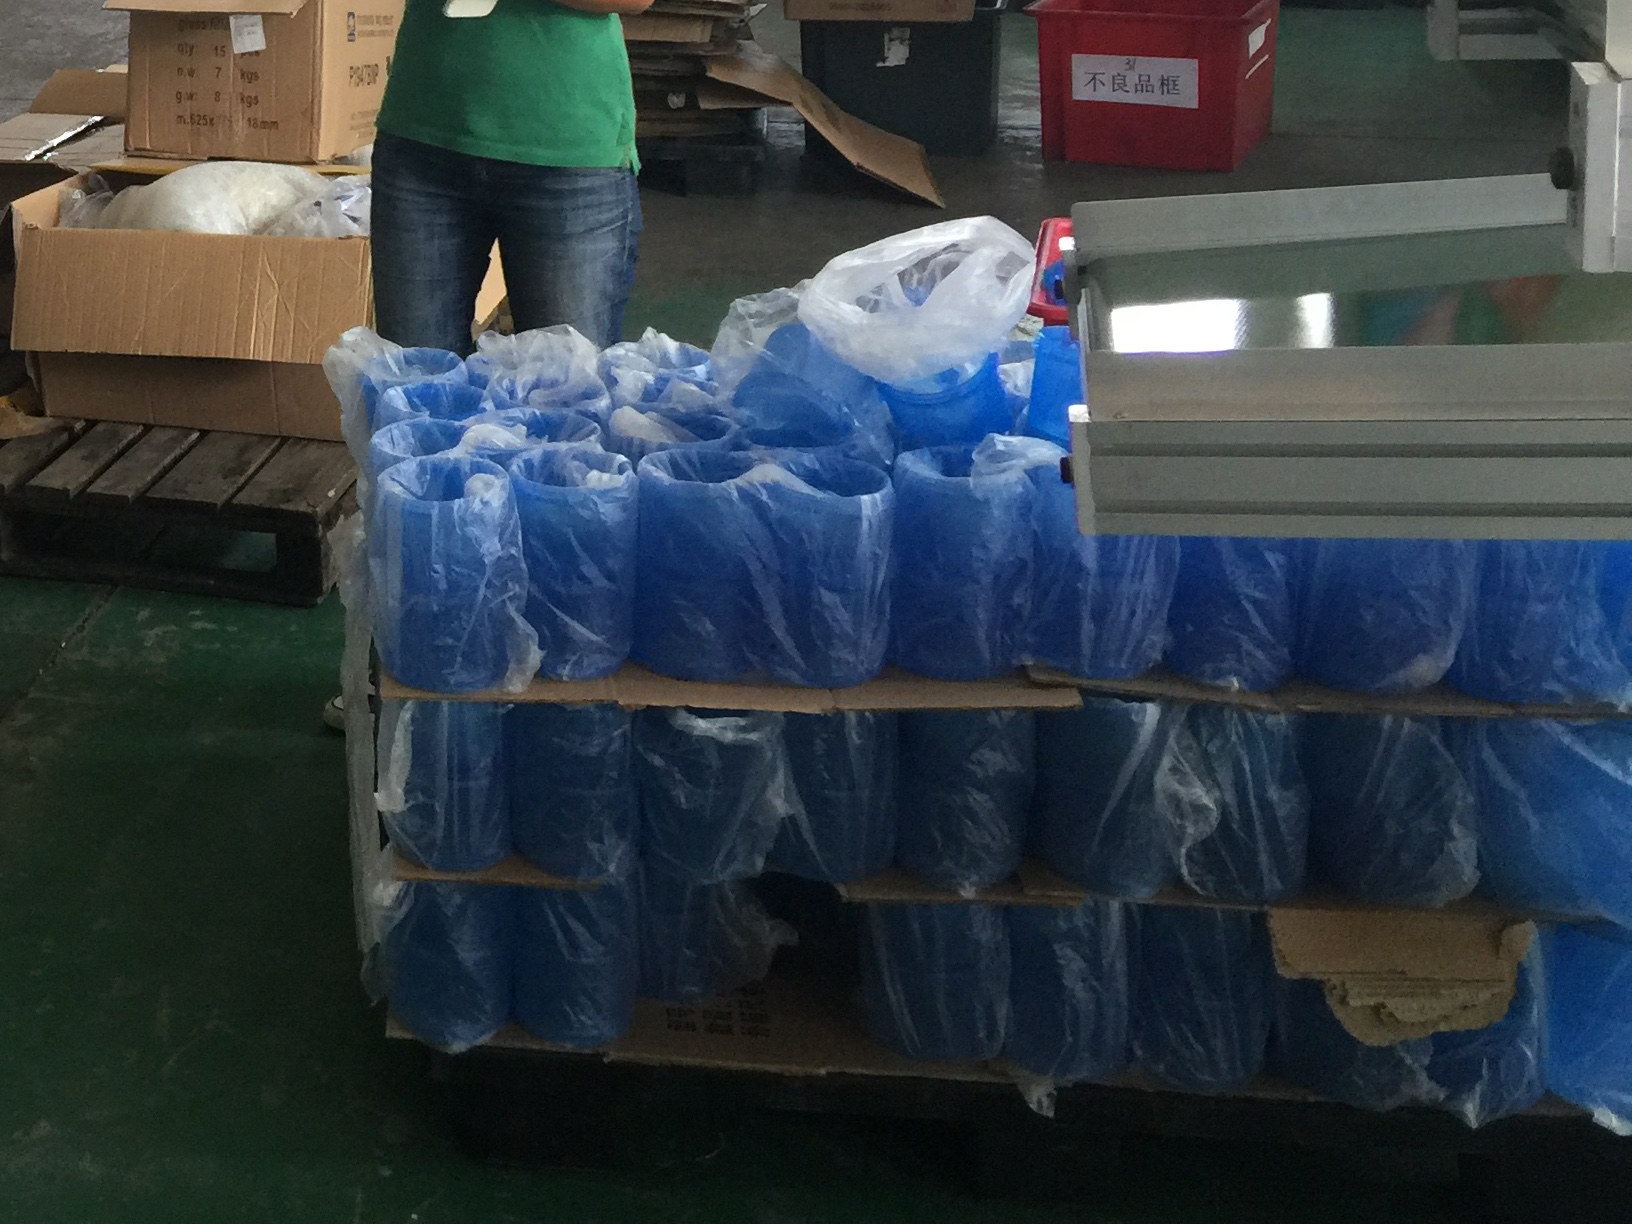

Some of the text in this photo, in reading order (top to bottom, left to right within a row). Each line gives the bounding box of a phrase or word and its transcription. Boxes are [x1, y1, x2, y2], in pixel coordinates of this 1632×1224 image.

[214, 45, 226, 58] 15
[215, 66, 222, 78] 7
[240, 68, 260, 84] kgs
[1083, 71, 1181, 96] 不良品框
[214, 91, 221, 102] 8
[240, 92, 259, 108] kgs
